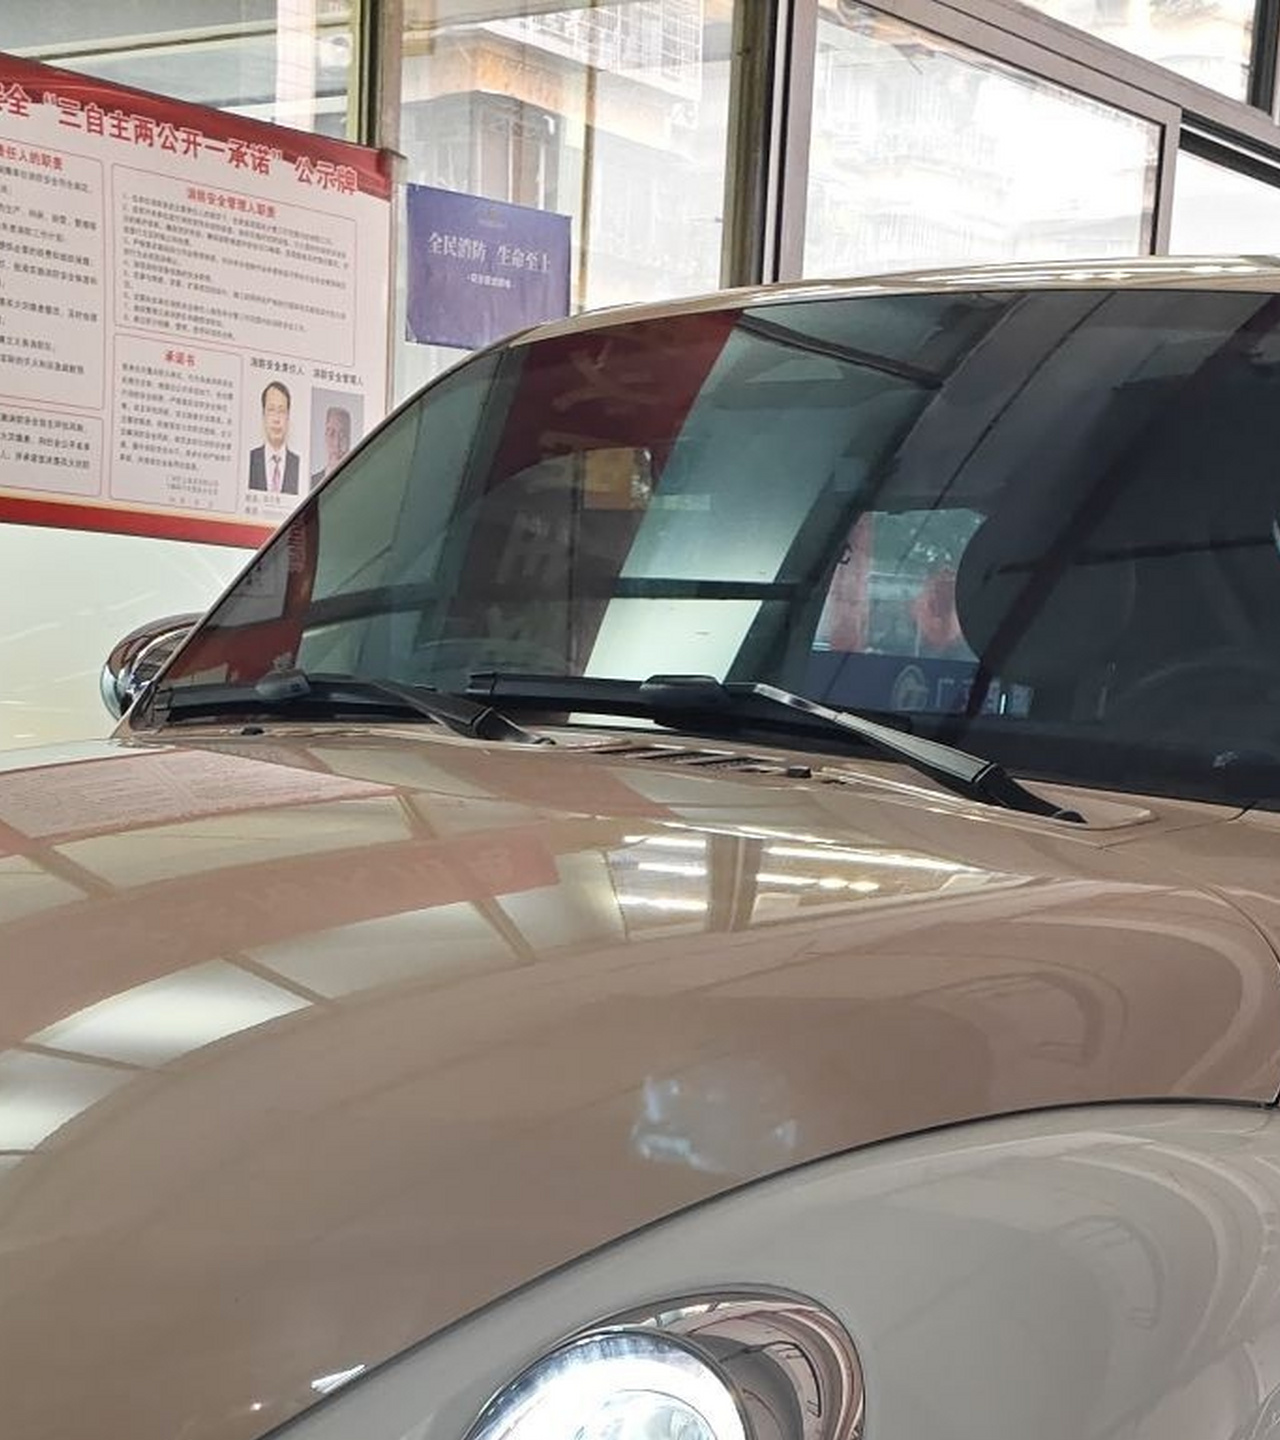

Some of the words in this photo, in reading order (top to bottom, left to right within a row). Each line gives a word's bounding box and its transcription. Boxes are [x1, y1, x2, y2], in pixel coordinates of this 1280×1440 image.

[427, 231, 487, 264] 全民消防
[495, 244, 552, 273] 生命至上
